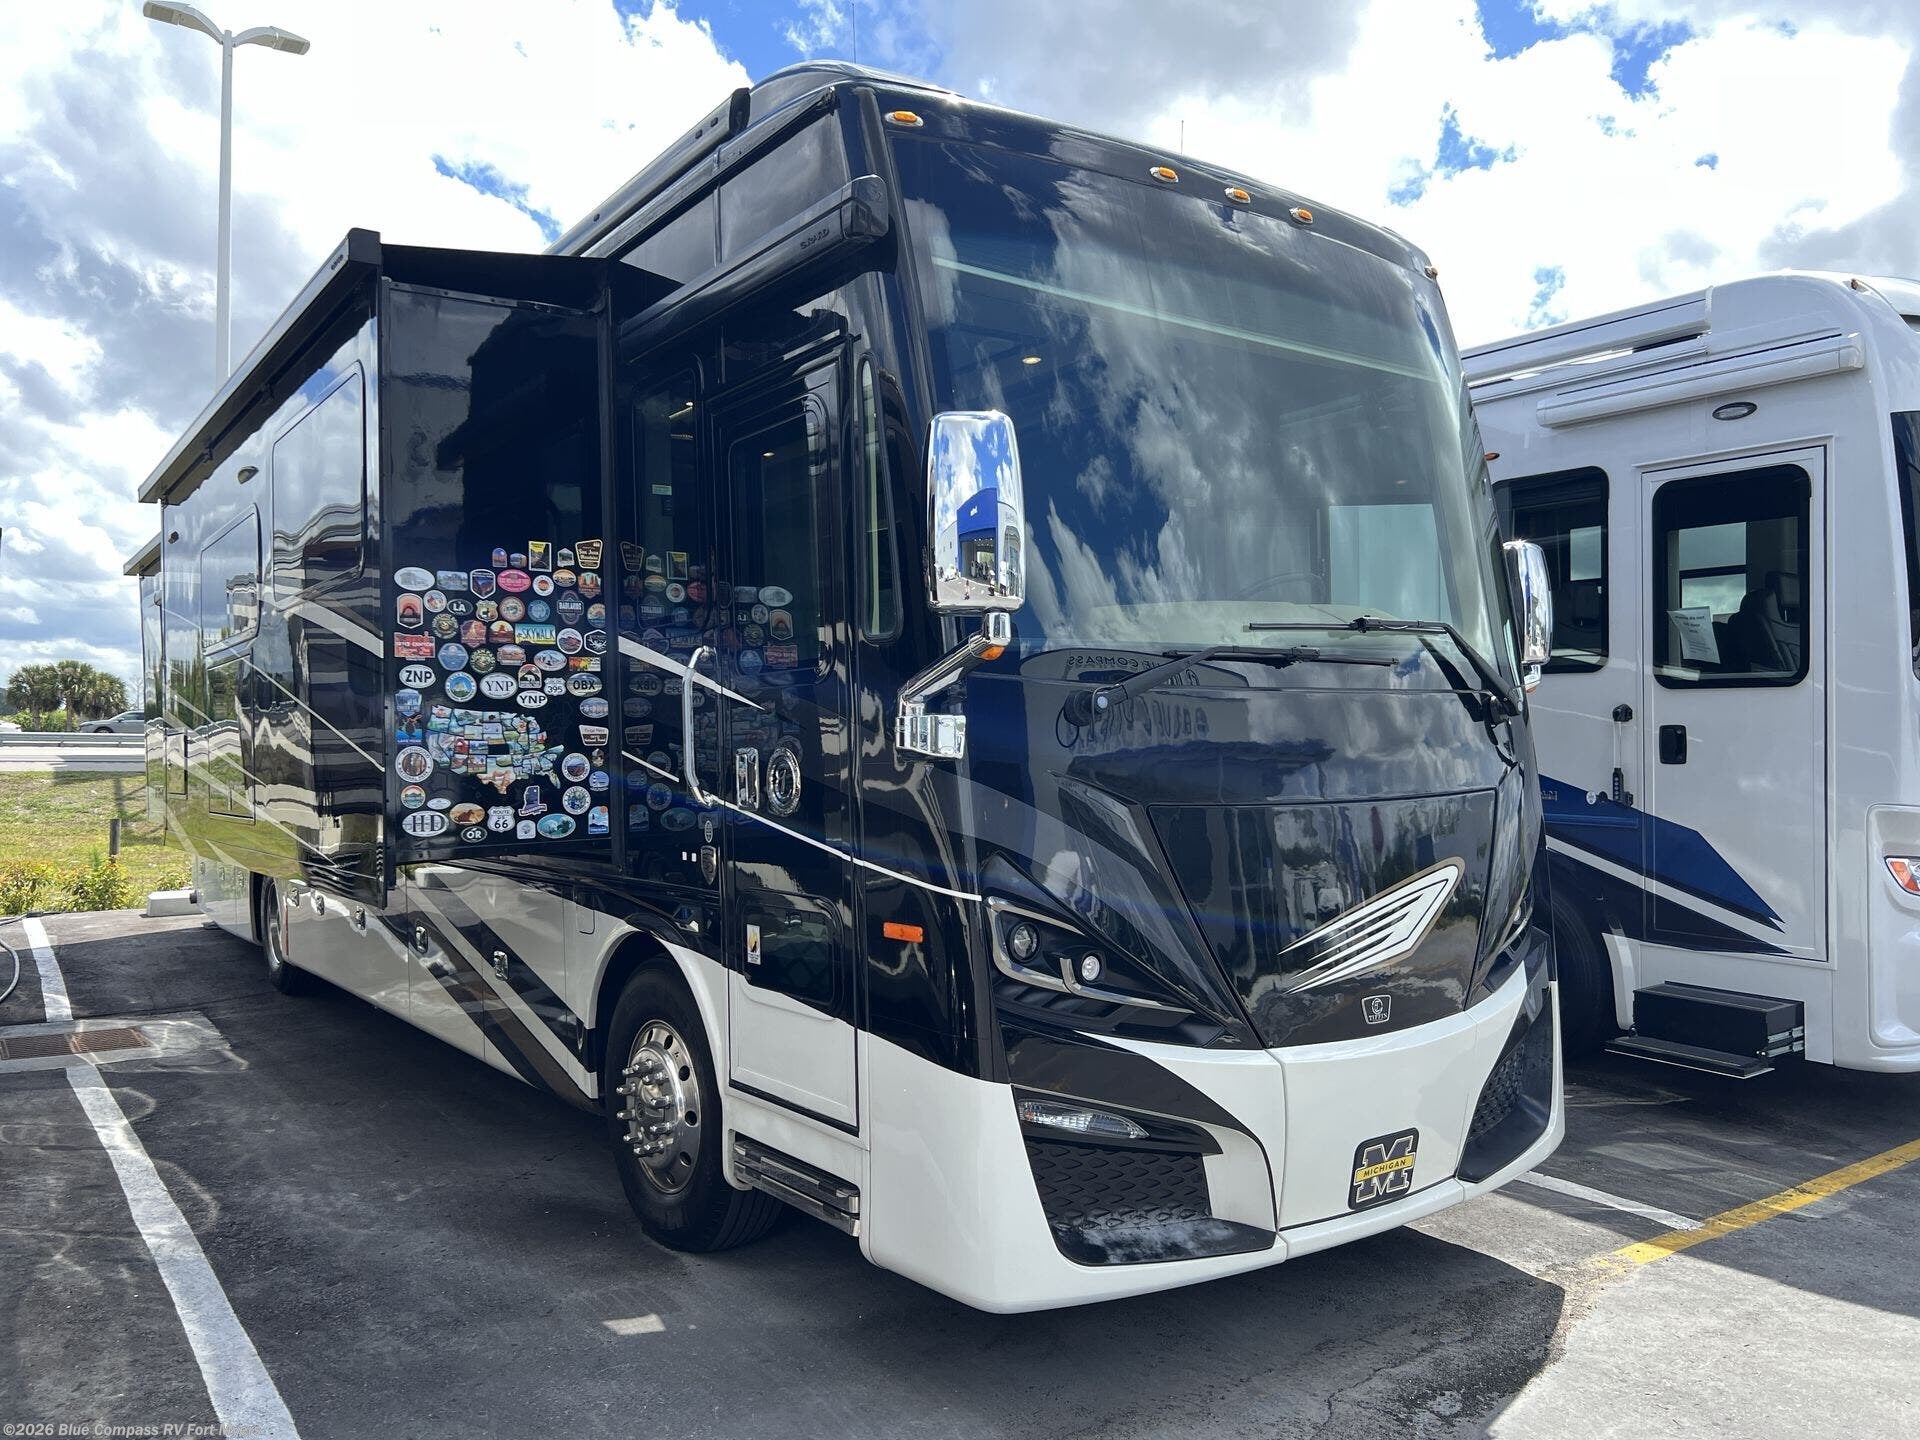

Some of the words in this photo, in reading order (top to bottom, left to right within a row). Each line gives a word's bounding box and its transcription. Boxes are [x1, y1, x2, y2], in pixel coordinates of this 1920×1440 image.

[453, 603, 466, 612] LA
[521, 627, 555, 640] SKYWALK
[405, 670, 432, 683] ZNP
[485, 680, 514, 692] YNP
[548, 685, 563, 693] 395
[573, 680, 596, 690] OBX
[519, 695, 546, 704] YNP
[411, 814, 446, 832] HD
[494, 819, 509, 829] 66
[1363, 1159, 1406, 1178] MICHIGAN
